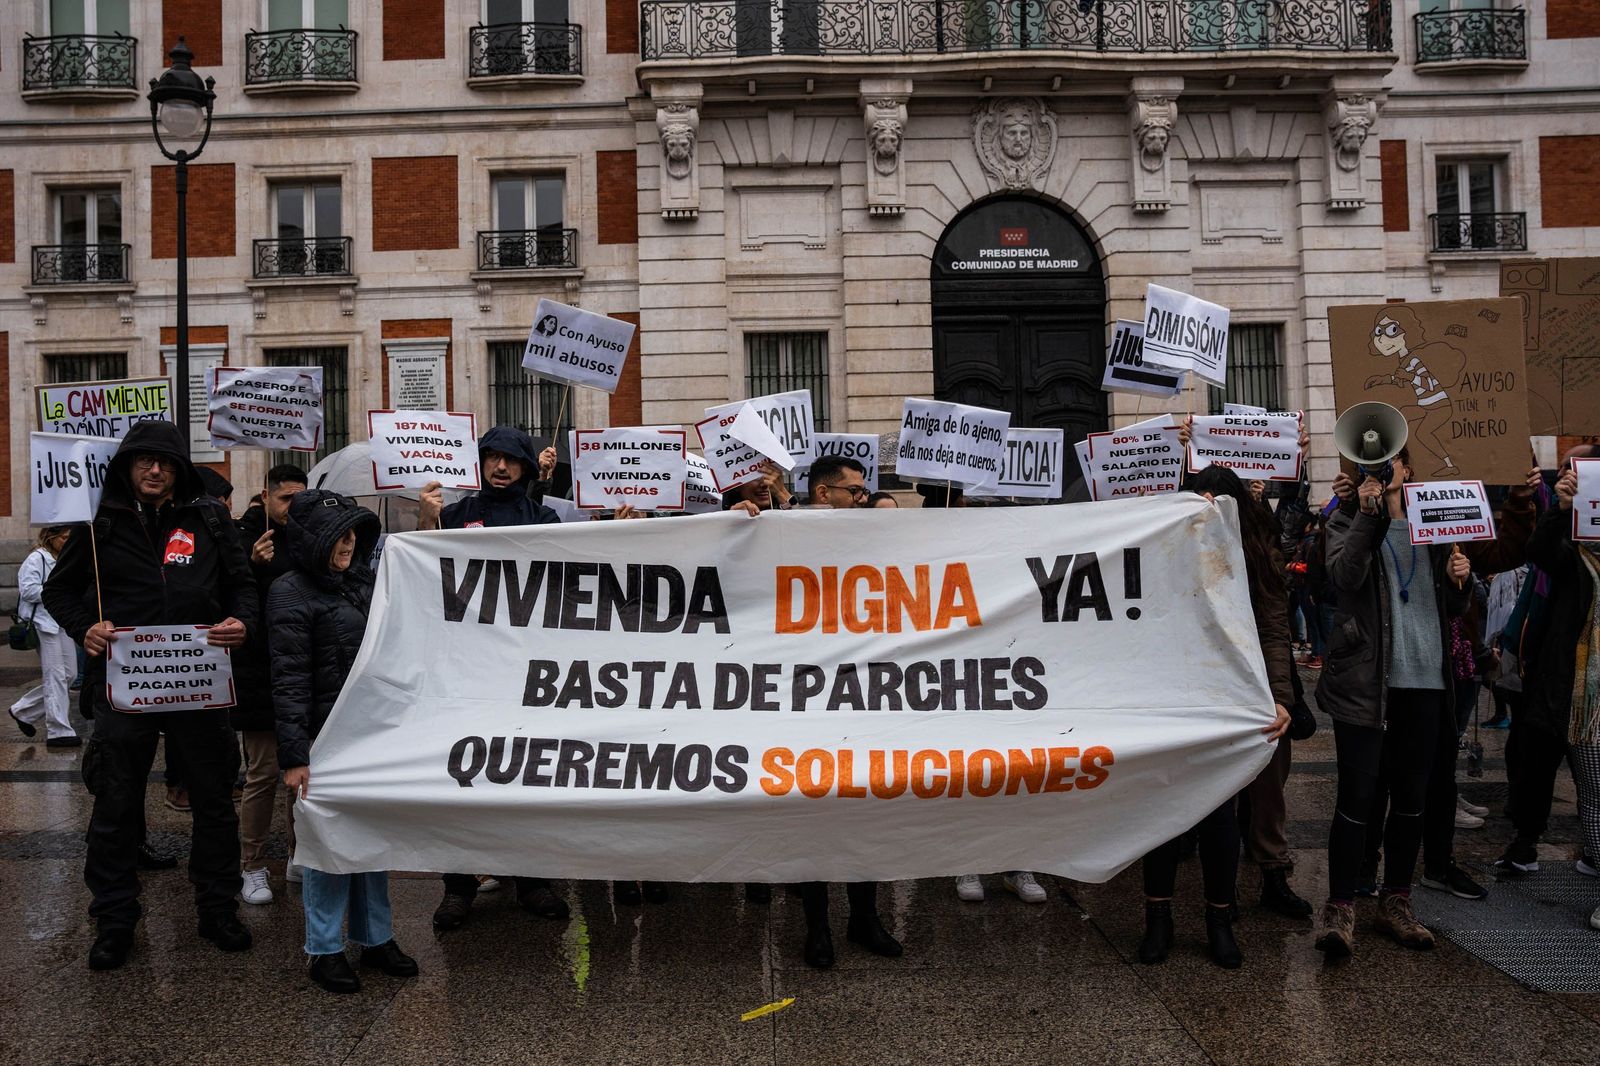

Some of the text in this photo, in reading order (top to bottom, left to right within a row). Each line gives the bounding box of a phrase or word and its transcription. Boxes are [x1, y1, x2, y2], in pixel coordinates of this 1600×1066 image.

[980, 248, 1050, 258] PRESIDENCIA
[951, 260, 1079, 270] COMUNIDAD DE MADRID
[559, 326, 625, 353] Con Ayuso
[1146, 306, 1226, 361] DIMISIÓN!
[528, 343, 618, 377] mil abusos.
[234, 379, 307, 393] CASEROS E
[1460, 371, 1515, 393] AYUSO
[43, 391, 65, 420] La
[217, 390, 319, 408] INMOBILIARIAS
[229, 402, 304, 418] SE FORRAN
[228, 414, 303, 430] A NUESTRA
[394, 422, 447, 432] 187 MIL
[903, 410, 1002, 446] Amiga de lo ajeno,
[1244, 418, 1269, 427] LOS
[242, 429, 286, 441] COSTA
[1112, 433, 1162, 445] 80% DE
[1209, 427, 1280, 438] RENTISTAS
[385, 436, 463, 448] VIVIENDAS
[603, 442, 682, 451] MILLONES
[400, 448, 453, 461] VACÍAS
[899, 440, 997, 473] ella nos deja en cueros.
[1109, 445, 1171, 458] NUESTRO
[1197, 448, 1291, 460] PRECARIEDAD
[620, 457, 641, 465] DE
[1101, 459, 1160, 471] SALARIO
[1162, 457, 1180, 465] EN
[388, 464, 466, 476] EN LA CAM
[591, 472, 671, 481] VIVIENDAS
[687, 470, 703, 480] DE
[1108, 471, 1155, 484] PAGAR
[603, 484, 659, 496] VACÍAS
[1416, 488, 1476, 502] MARINA
[1417, 524, 1486, 537] EN MADRID
[167, 552, 193, 564] CGT
[439, 556, 731, 634] VIVIENDA
[774, 562, 983, 634] DIGNA
[134, 633, 193, 643] 80% DE
[130, 649, 204, 658] NUESTRO
[121, 663, 217, 674] SALARIO EN
[128, 678, 213, 690] PAGAR UN
[521, 656, 1048, 712] BASTA DE PARCHES
[131, 693, 213, 706] ALQUILER
[447, 735, 1115, 800] QUEREMOS SOLUCIONES
